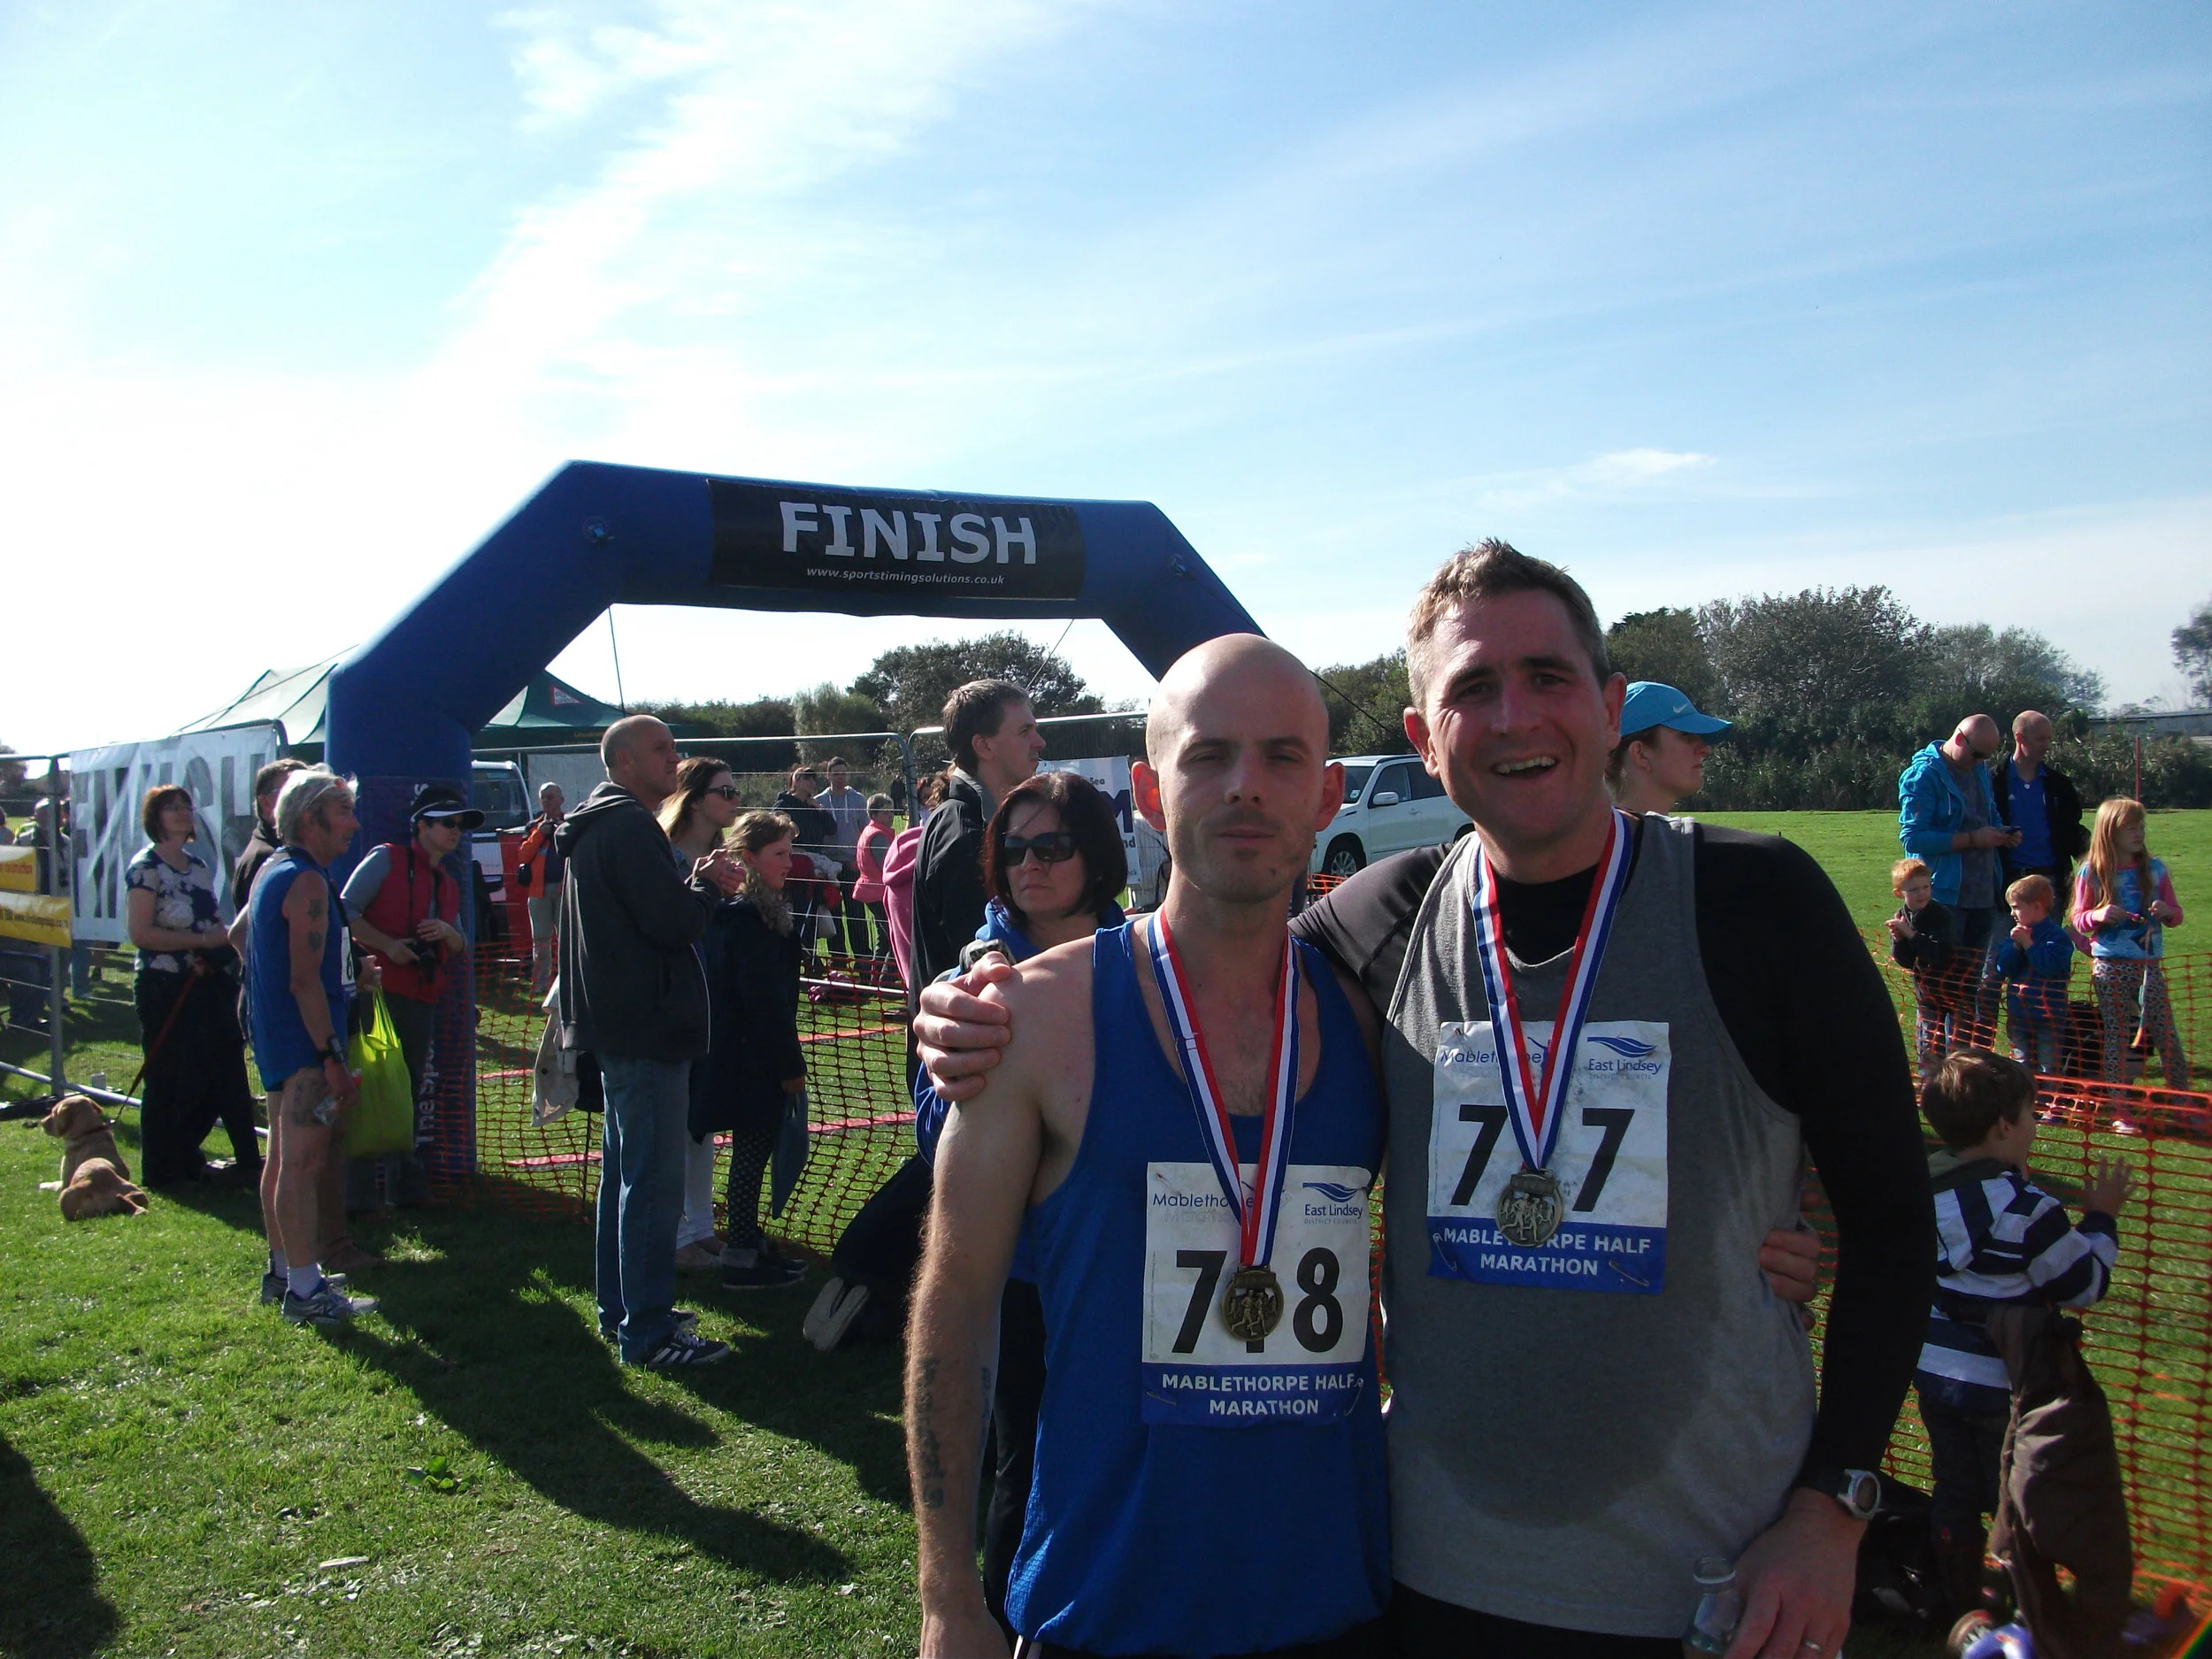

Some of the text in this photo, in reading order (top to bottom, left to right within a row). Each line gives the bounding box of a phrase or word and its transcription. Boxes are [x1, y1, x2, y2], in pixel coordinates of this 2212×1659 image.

[780, 501, 1037, 565] FINISH
[806, 567, 1005, 586] www.sportstimingsolutions.co.uk
[1440, 1050, 1542, 1064] Mablete
[1588, 1058, 1662, 1075] East Lindsey
[1152, 1193, 1254, 1208] Mablethoe
[1304, 1203, 1363, 1219] East Lindsey
[1444, 1227, 1651, 1254] MABLERPE HALF
[1480, 1253, 1598, 1276] MARATHON
[1171, 1247, 1343, 1354] 78
[1162, 1373, 1356, 1392] MABLETHORPE HALF
[1209, 1399, 1319, 1416] MARATHON
